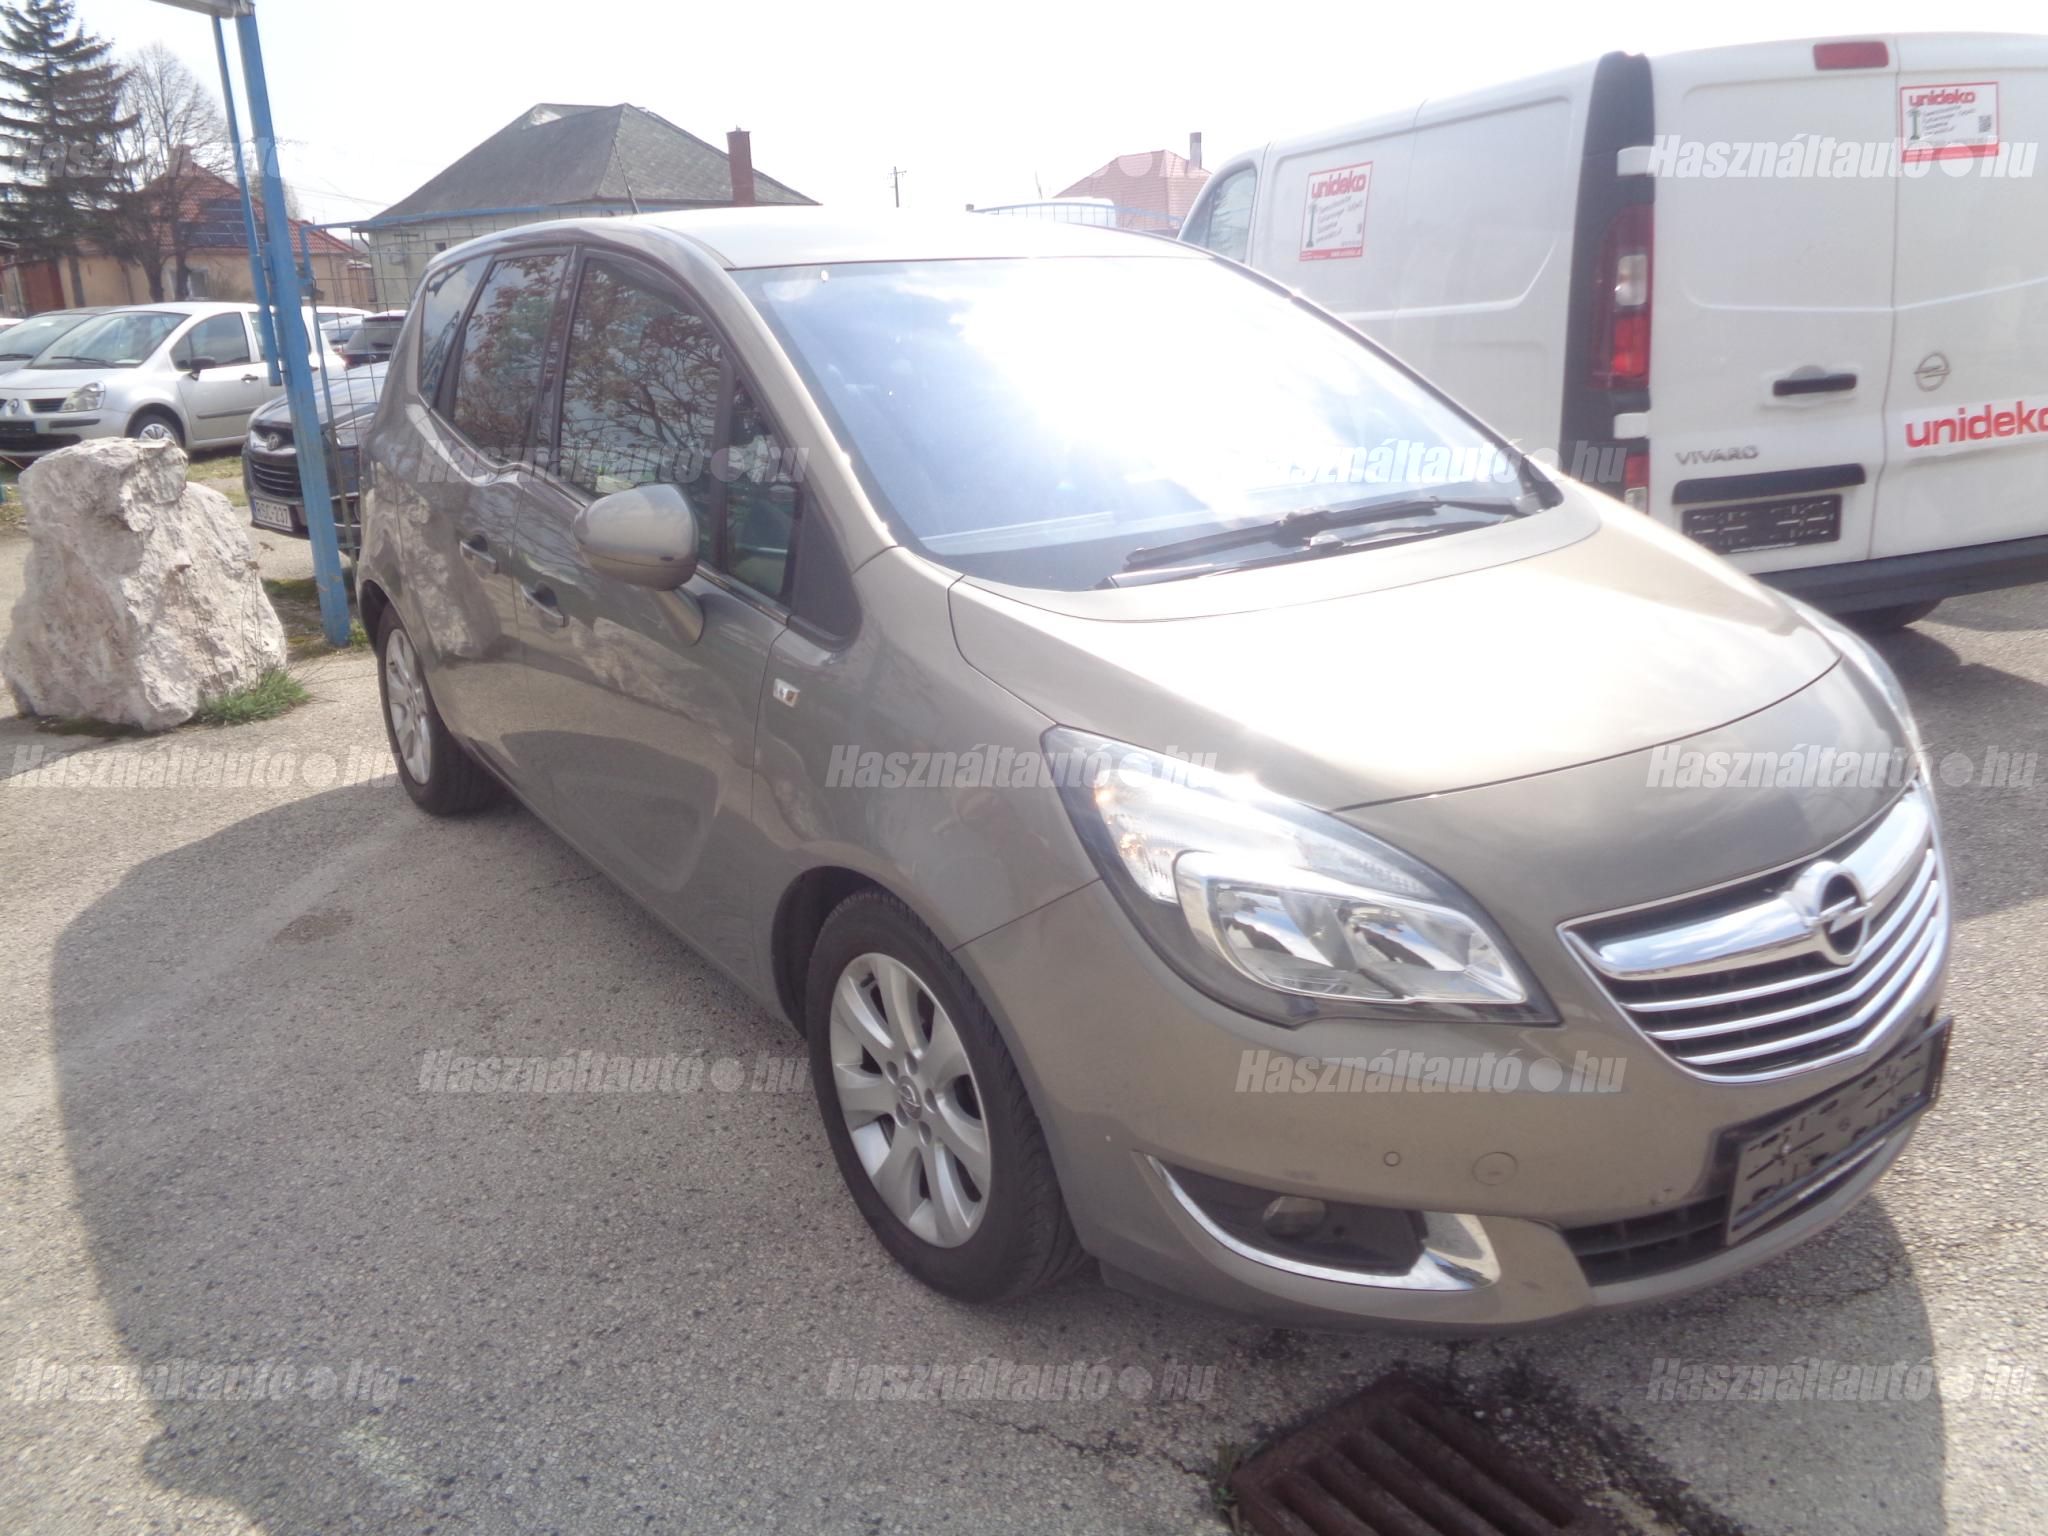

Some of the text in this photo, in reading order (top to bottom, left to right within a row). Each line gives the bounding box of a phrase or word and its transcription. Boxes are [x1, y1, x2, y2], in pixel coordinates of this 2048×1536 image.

[1908, 88, 1976, 107] unideko
[1311, 170, 1367, 199] unideko
[1675, 445, 1760, 466] VIVARO
